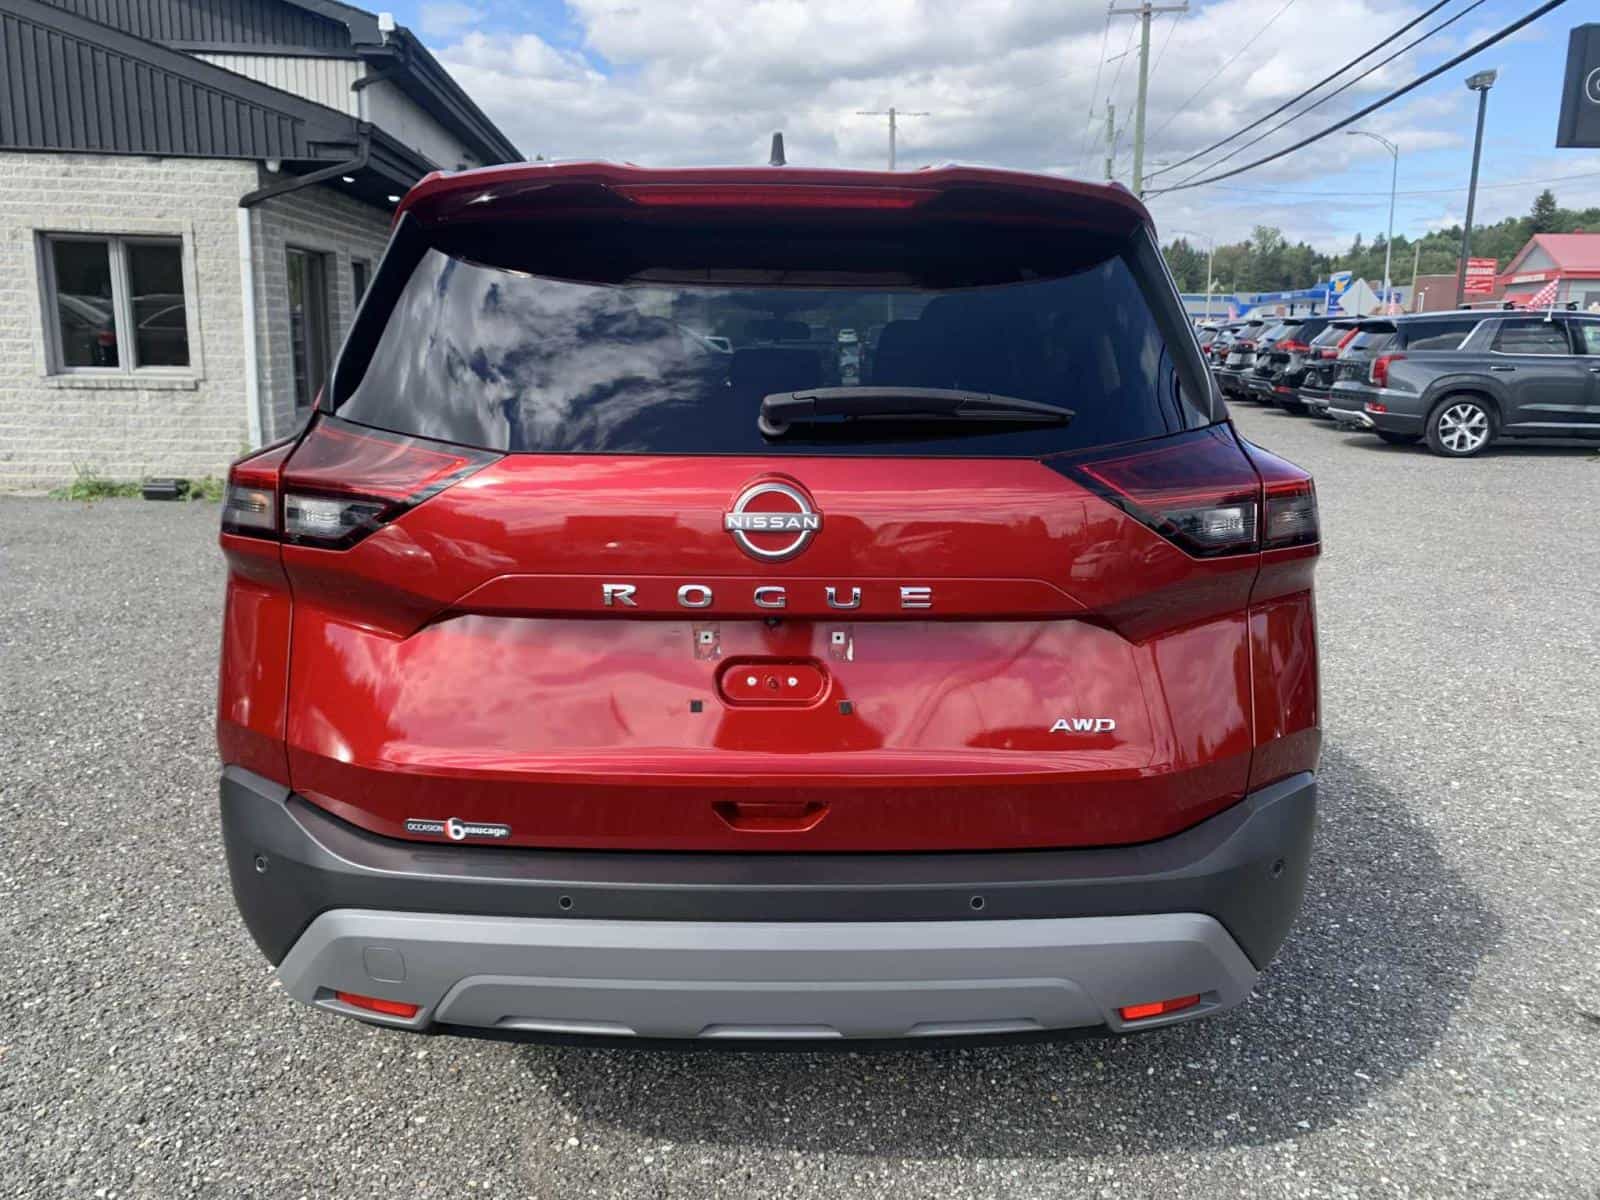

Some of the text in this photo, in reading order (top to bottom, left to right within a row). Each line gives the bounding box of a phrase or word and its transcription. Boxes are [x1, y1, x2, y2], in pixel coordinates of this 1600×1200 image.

[727, 515, 819, 529] NISSAN
[602, 583, 933, 609] ROGUE
[1049, 718, 1116, 733] AWD
[407, 822, 444, 833] OCCASION
